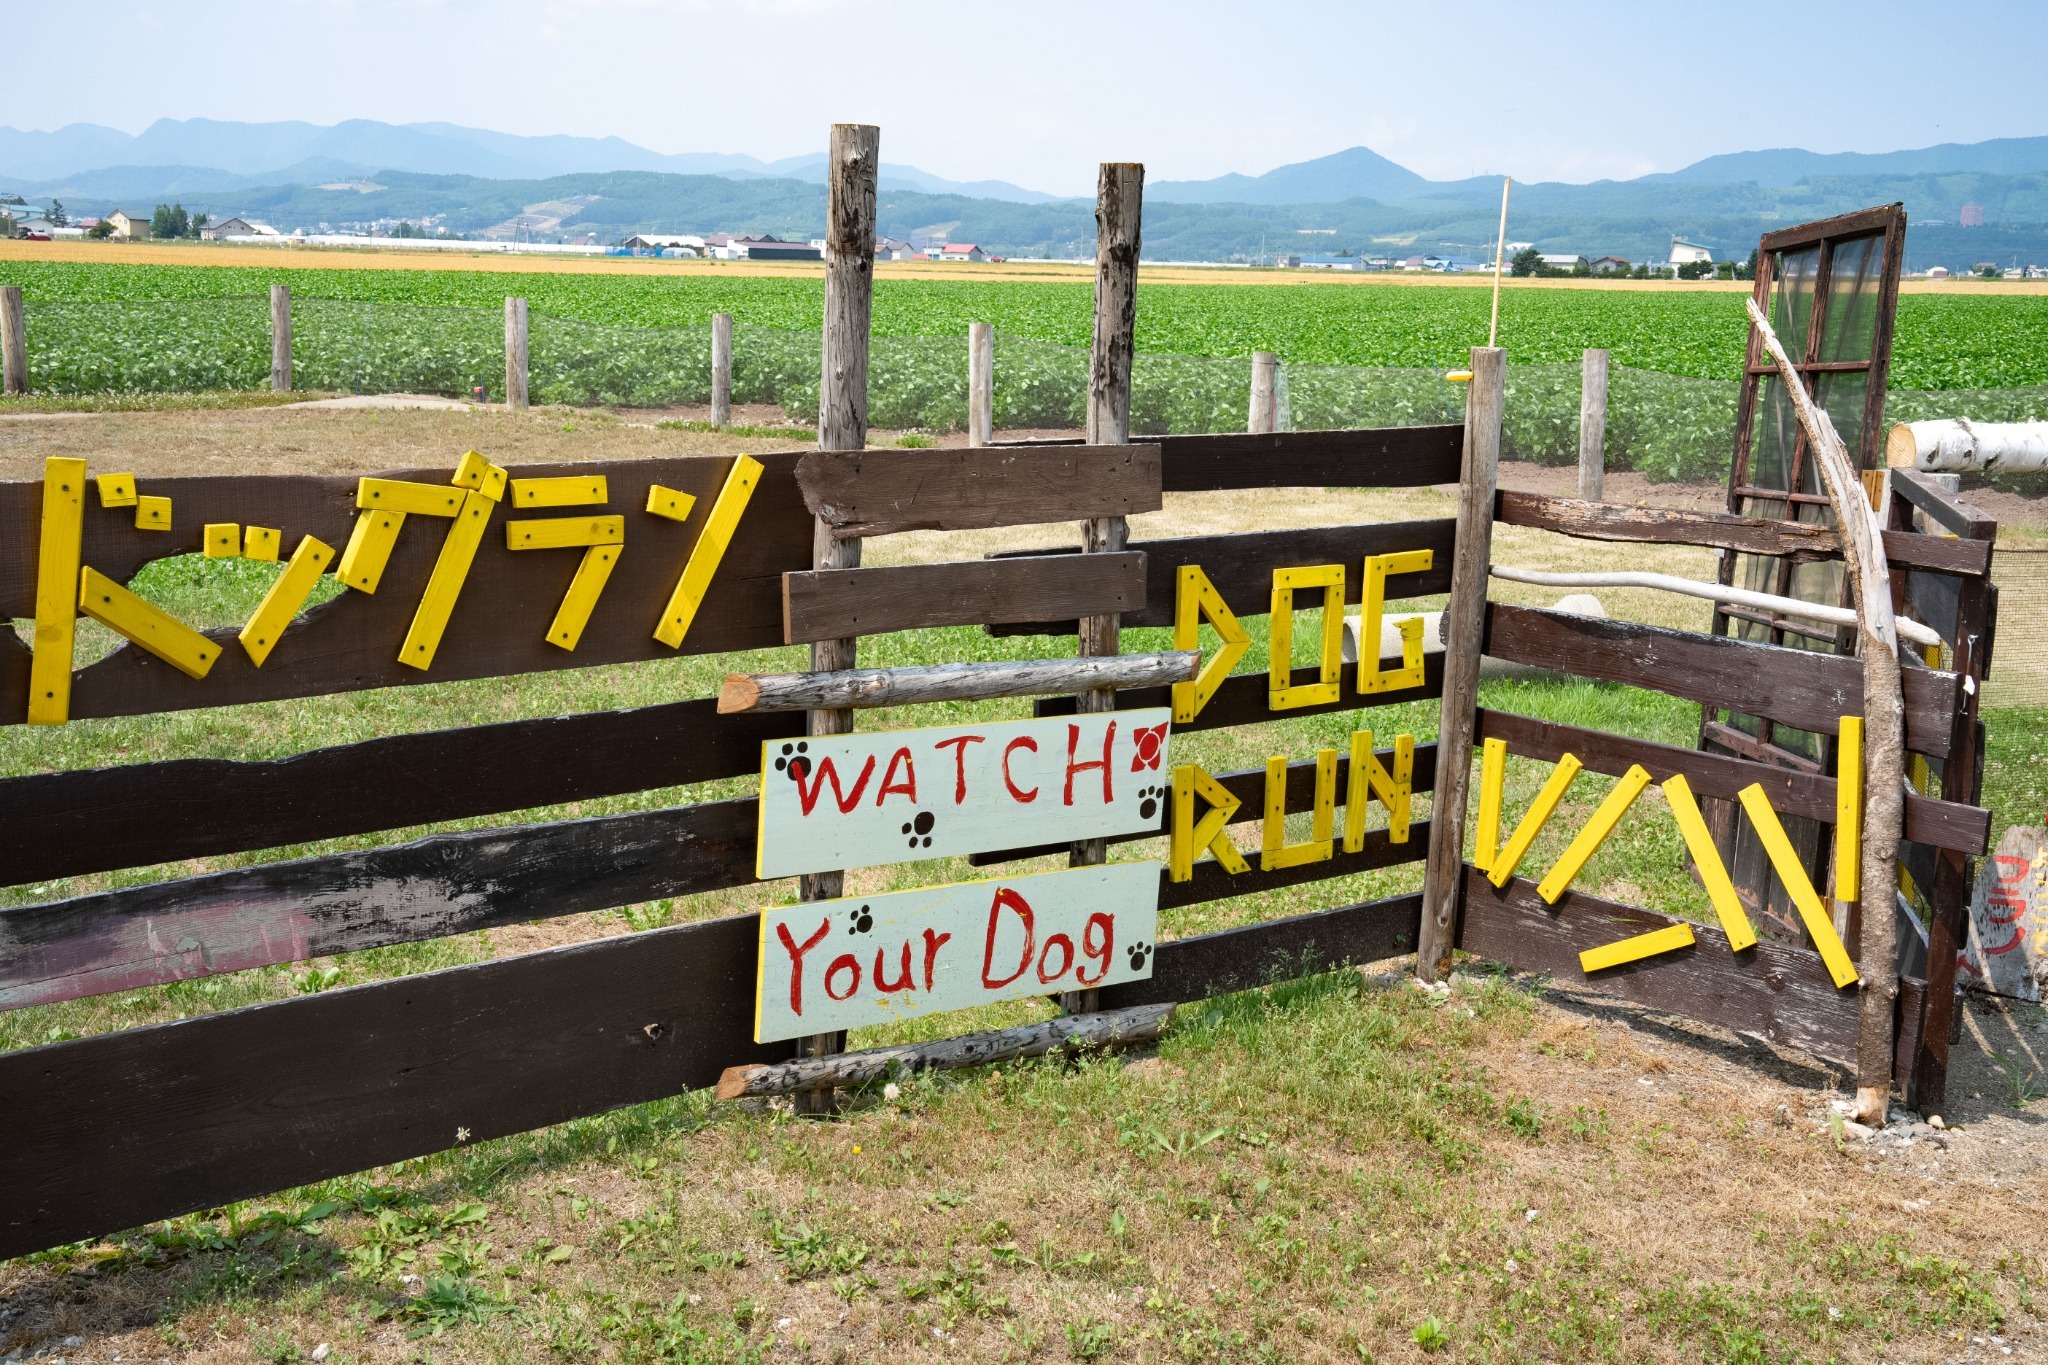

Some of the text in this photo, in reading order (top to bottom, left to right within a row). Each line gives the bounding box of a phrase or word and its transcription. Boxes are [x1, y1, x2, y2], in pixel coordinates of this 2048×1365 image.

[27, 450, 765, 725] ドッグラン
[1172, 549, 1434, 723] DOG
[792, 719, 1117, 817] WATCH
[1170, 730, 1414, 883] RUN
[776, 886, 1115, 1017] Your Dog
